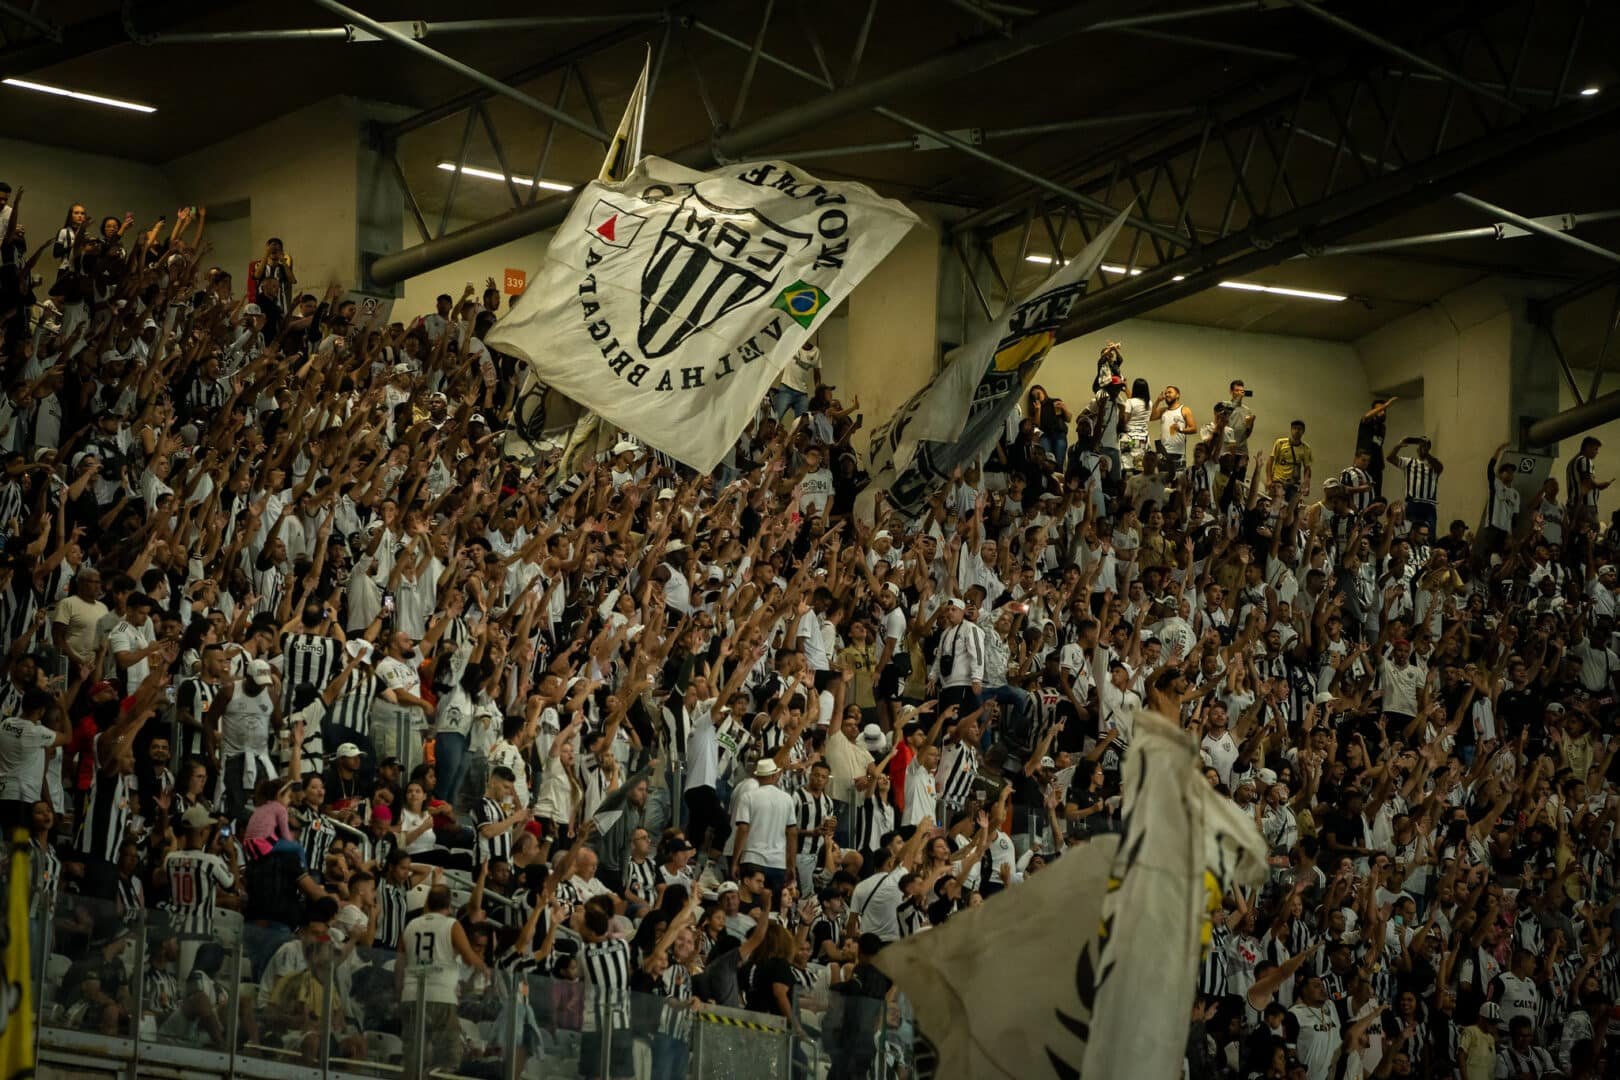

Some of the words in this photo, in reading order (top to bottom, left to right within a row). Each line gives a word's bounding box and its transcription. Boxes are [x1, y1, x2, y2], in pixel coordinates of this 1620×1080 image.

[506, 276, 524, 289] 339
[174, 873, 193, 903] 10
[415, 933, 434, 964] 13
